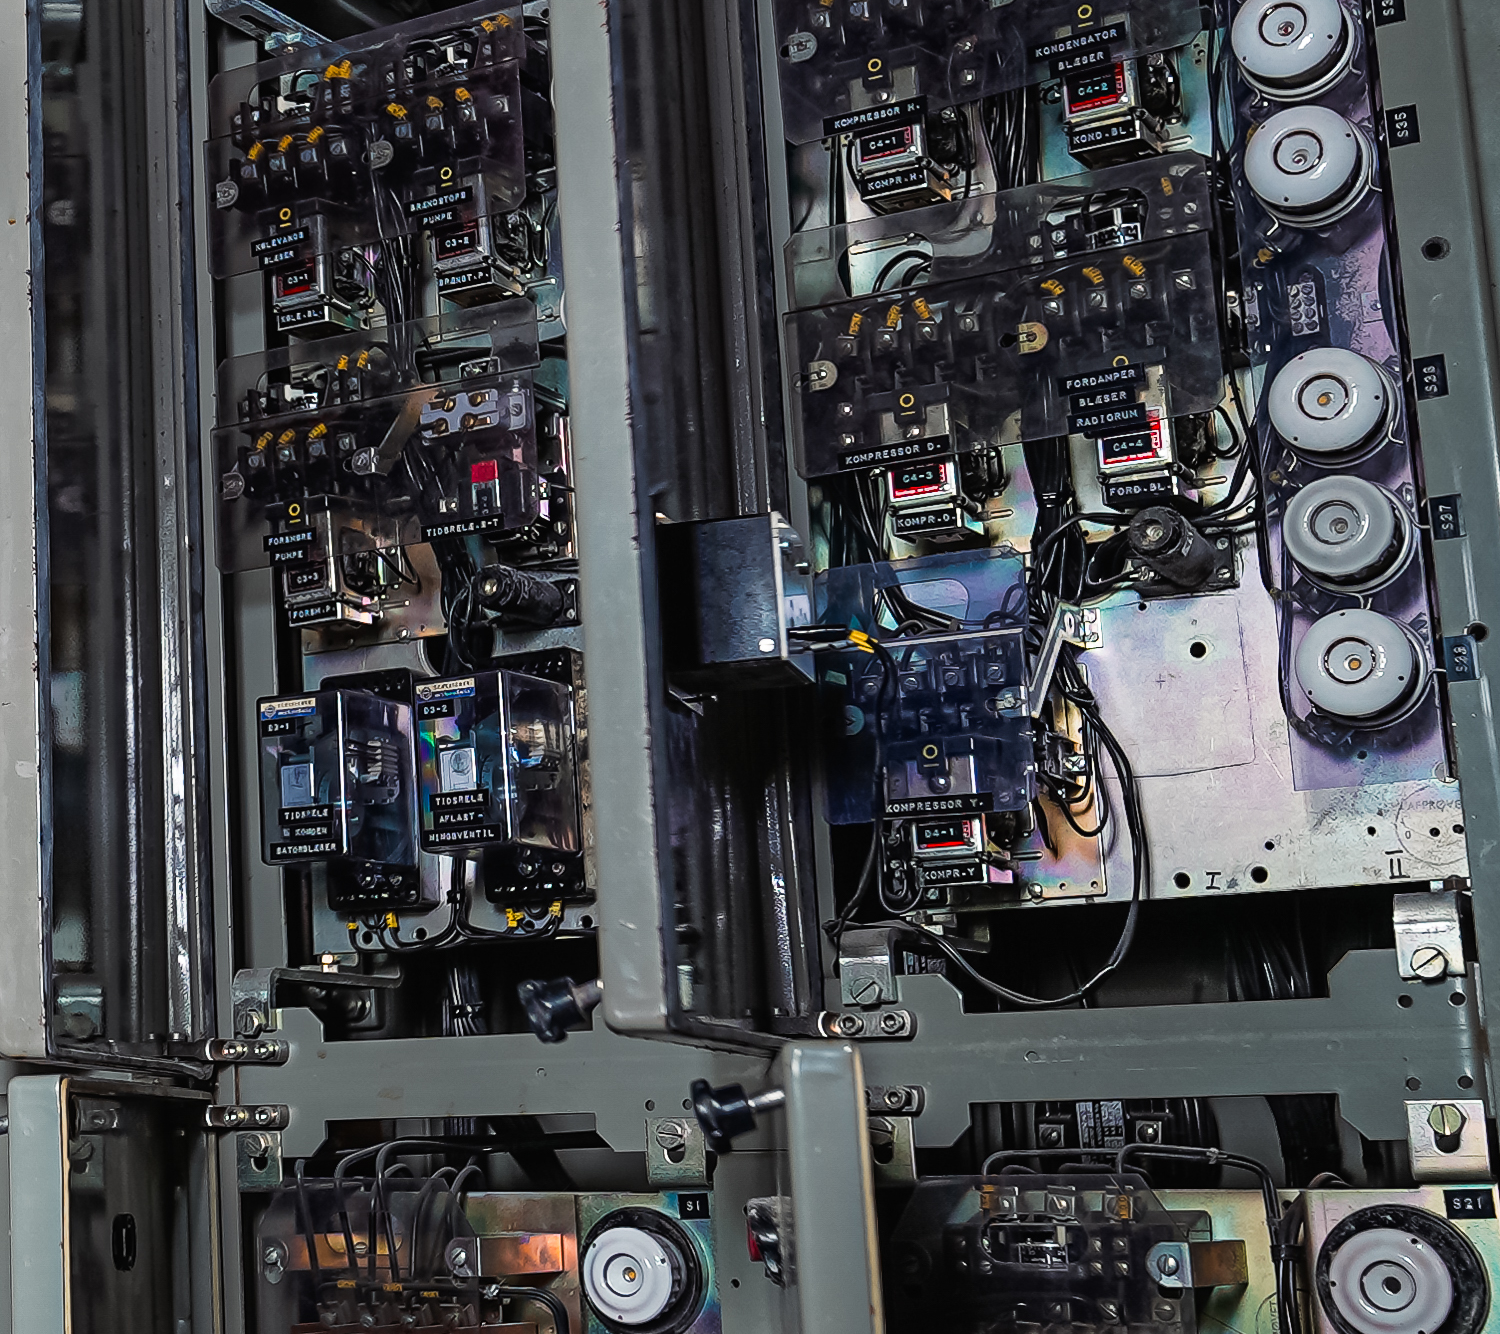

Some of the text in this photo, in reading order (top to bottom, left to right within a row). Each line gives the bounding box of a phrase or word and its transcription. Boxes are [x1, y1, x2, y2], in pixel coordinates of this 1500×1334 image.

[1034, 28, 1118, 58] KONDENSATOR
[1077, 82, 1109, 97] C4-2
[834, 106, 901, 128] KOMPRESSOR
[1394, 111, 1409, 138] S35
[868, 136, 897, 151] C4-1
[1078, 389, 1127, 407] BLÆSER
[845, 444, 921, 465] KOMPRESSOR
[902, 469, 934, 483] C4-3
[924, 827, 955, 838] D4-1
[686, 1200, 700, 1212] S1
[1452, 1196, 1483, 1211] S21
